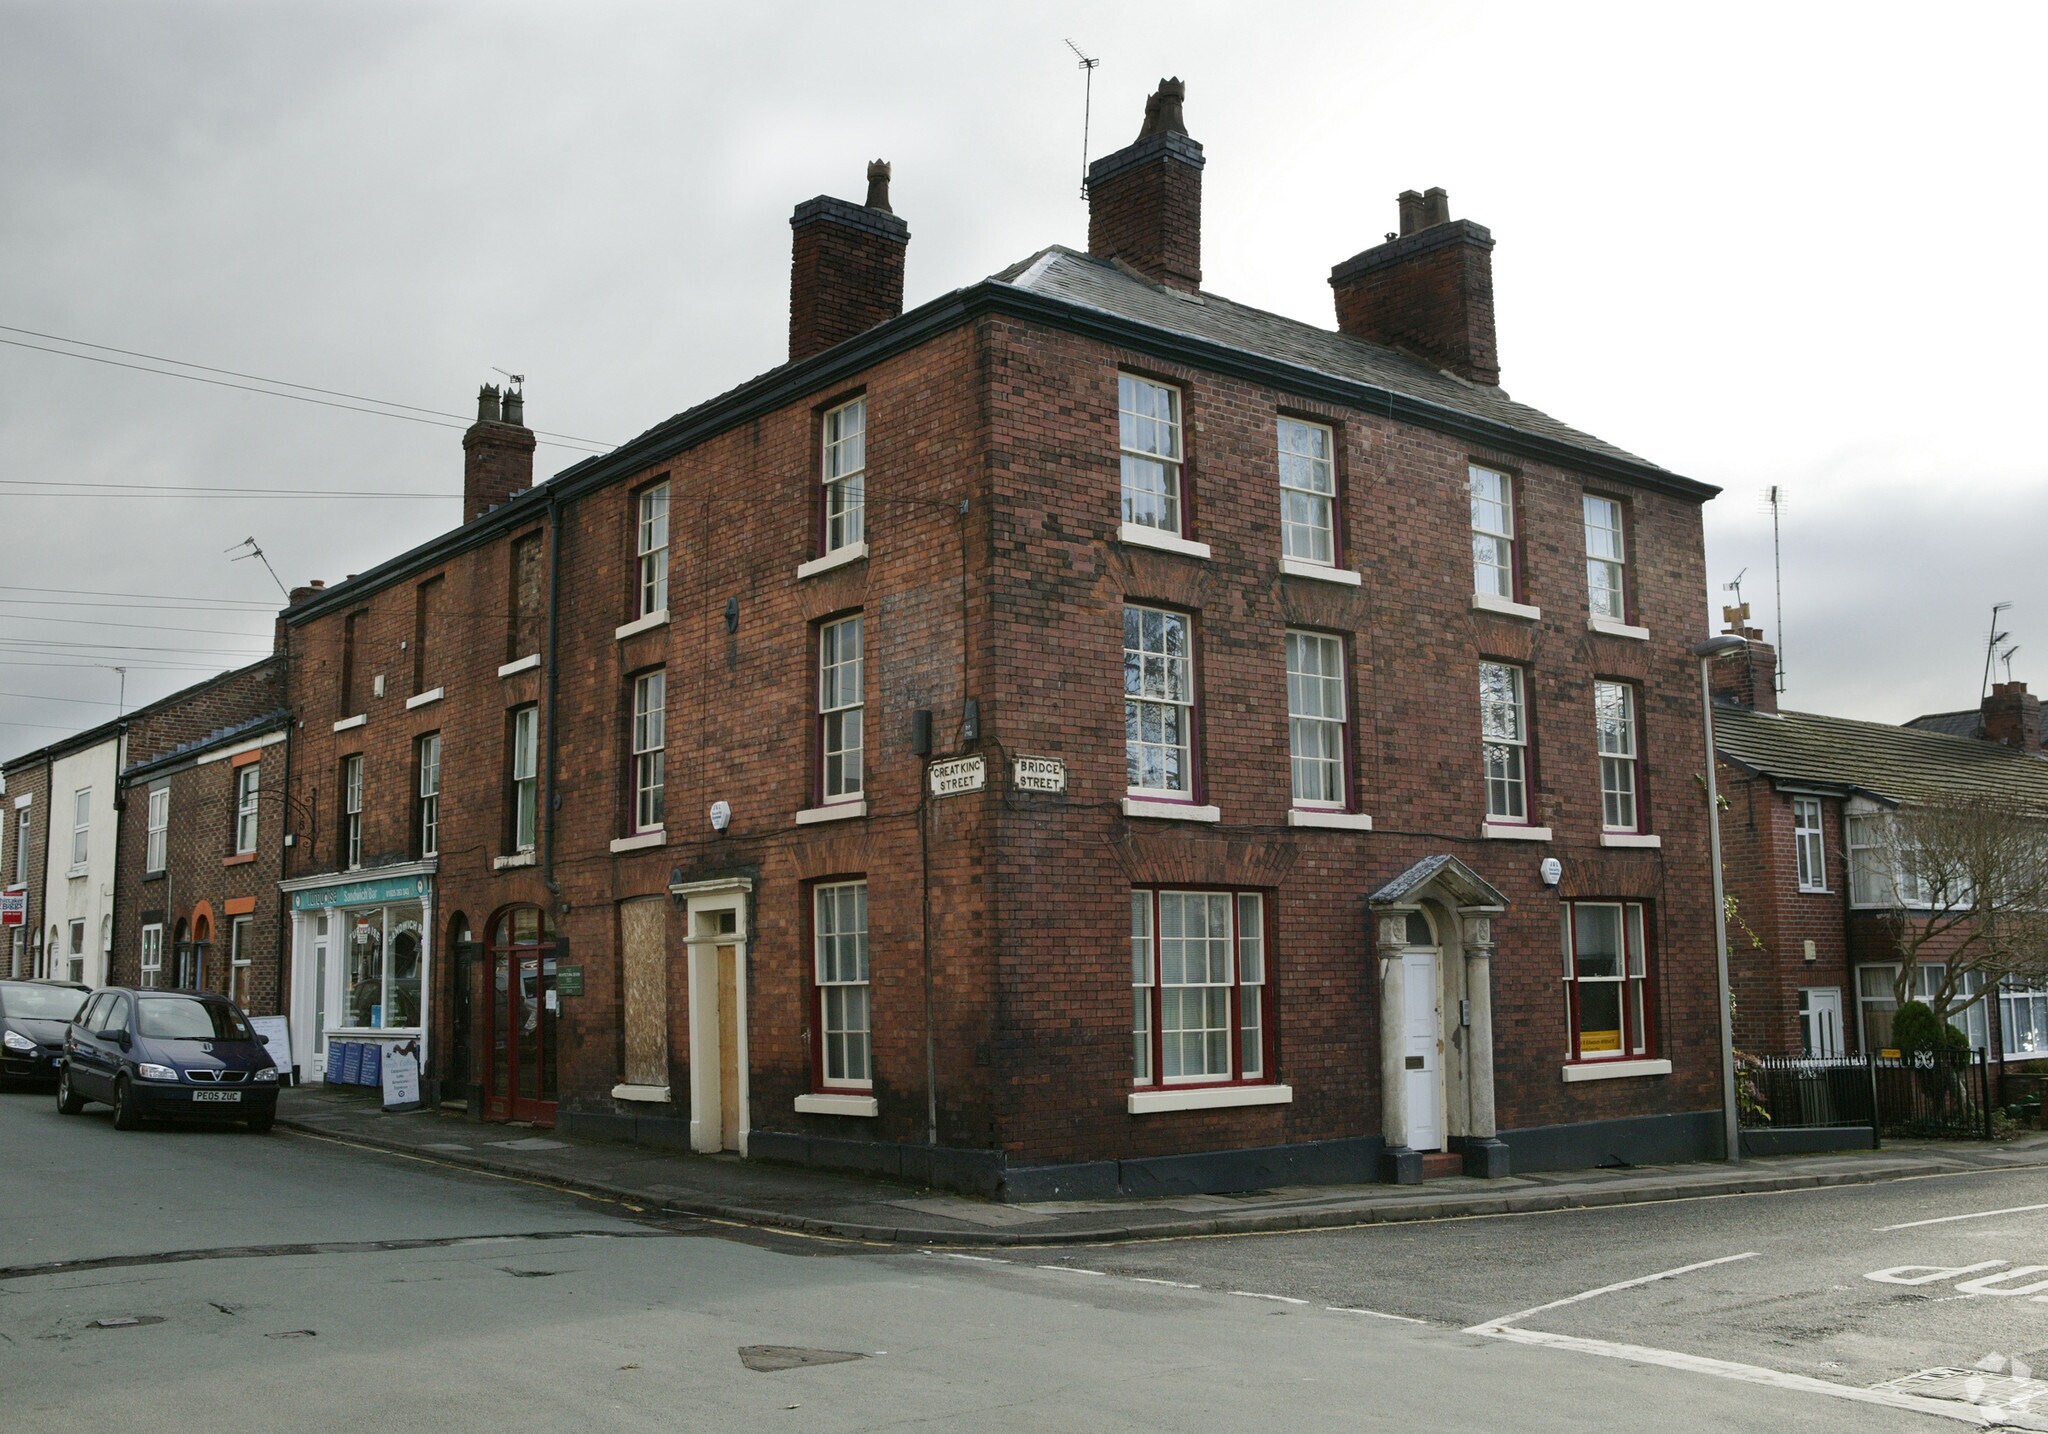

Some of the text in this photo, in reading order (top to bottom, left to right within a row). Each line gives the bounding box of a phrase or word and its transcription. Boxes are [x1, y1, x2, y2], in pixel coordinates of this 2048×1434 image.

[934, 760, 981, 778] GREAT KING
[1020, 760, 1060, 775] BRIDGE
[940, 775, 975, 791] STREET
[1020, 776, 1060, 790] STREET
[343, 888, 368, 903] Sandwich
[368, 887, 378, 900] Bar
[196, 1092, 219, 1100] PE05
